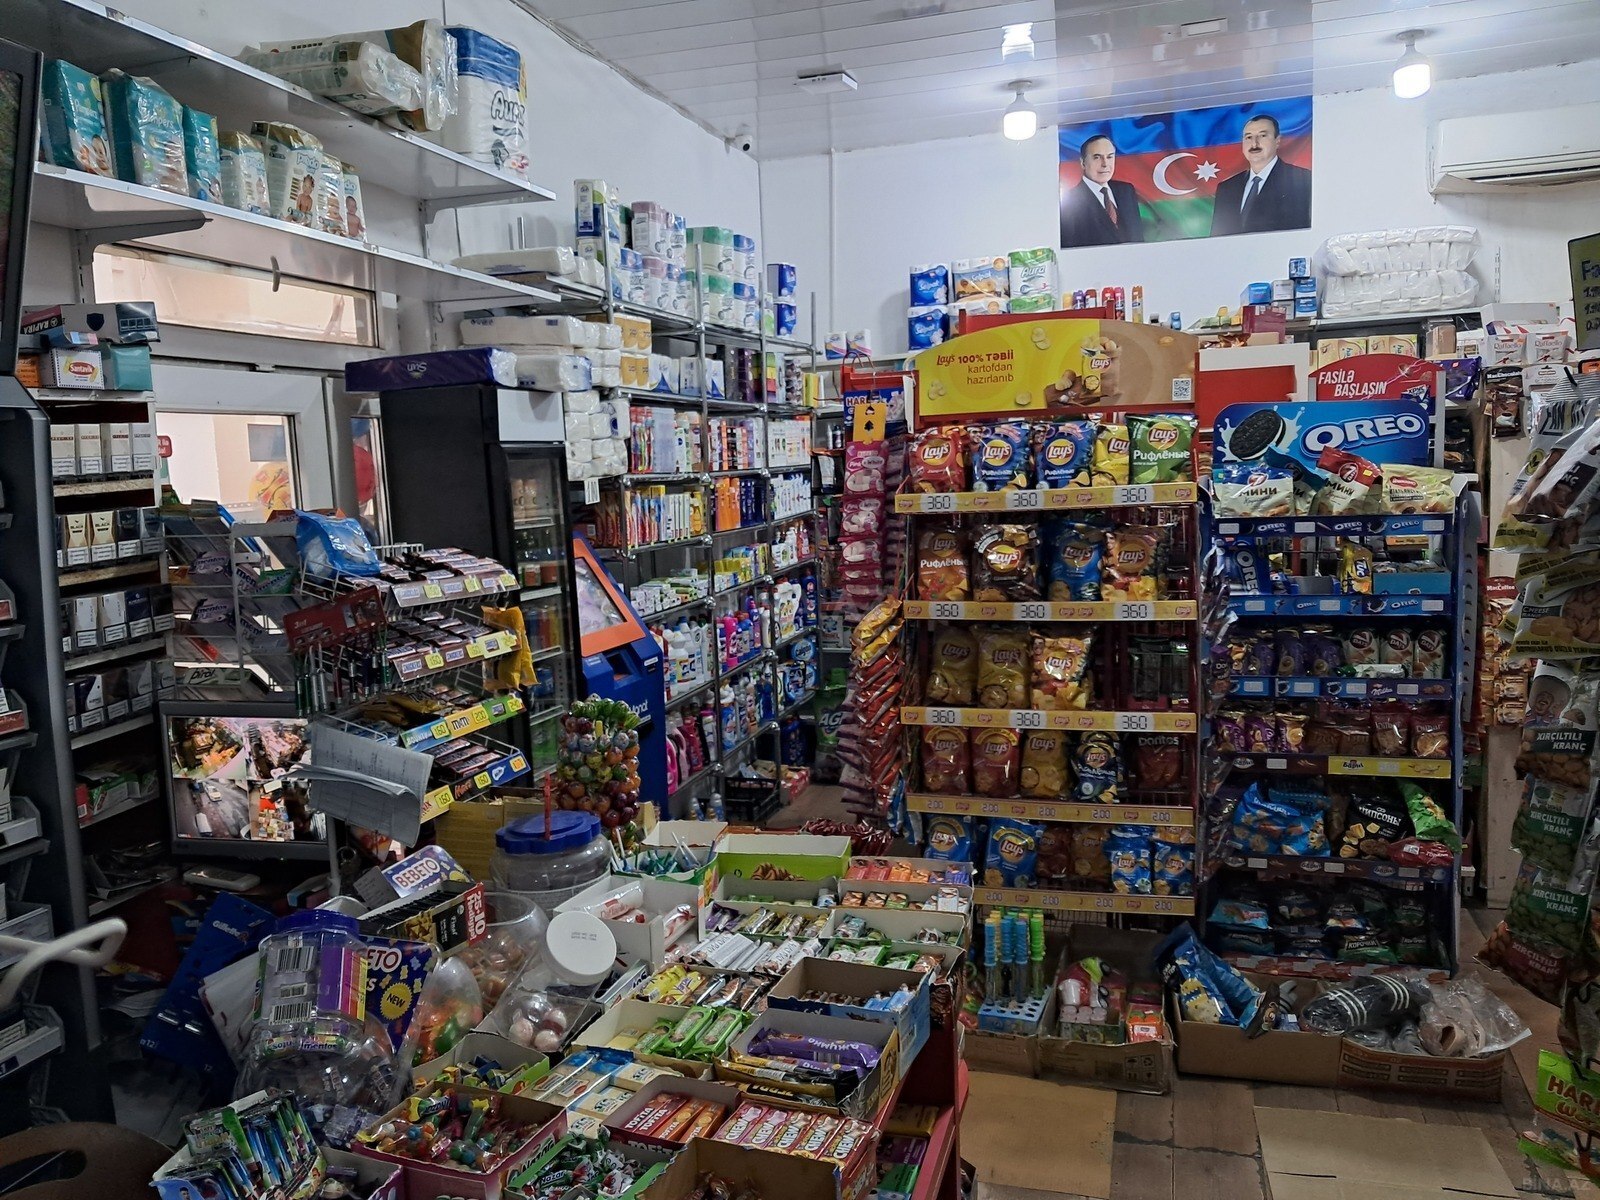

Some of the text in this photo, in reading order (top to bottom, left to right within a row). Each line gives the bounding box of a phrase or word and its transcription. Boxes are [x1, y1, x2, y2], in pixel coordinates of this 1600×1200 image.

[1021, 264, 1047, 279] Aura
[1493, 341, 1523, 351] Raffaello
[1534, 339, 1564, 349] Raffaello
[958, 354, 984, 364] 100%
[968, 363, 1013, 374] kartofdan
[966, 373, 1015, 385] hazırlanıb
[1318, 369, 1355, 385] FASİLƏ
[1303, 413, 1424, 452] OREO
[1107, 435, 1131, 454] Lay
[1133, 449, 1191, 465] Рифлёные
[1552, 741, 1587, 752] KRANÇ
[1543, 823, 1574, 837] KRANÇ
[395, 859, 438, 888] BEBETO
[1546, 901, 1579, 915] KRANÇ
[367, 948, 399, 970] ETO
[385, 992, 406, 1008] NEW
